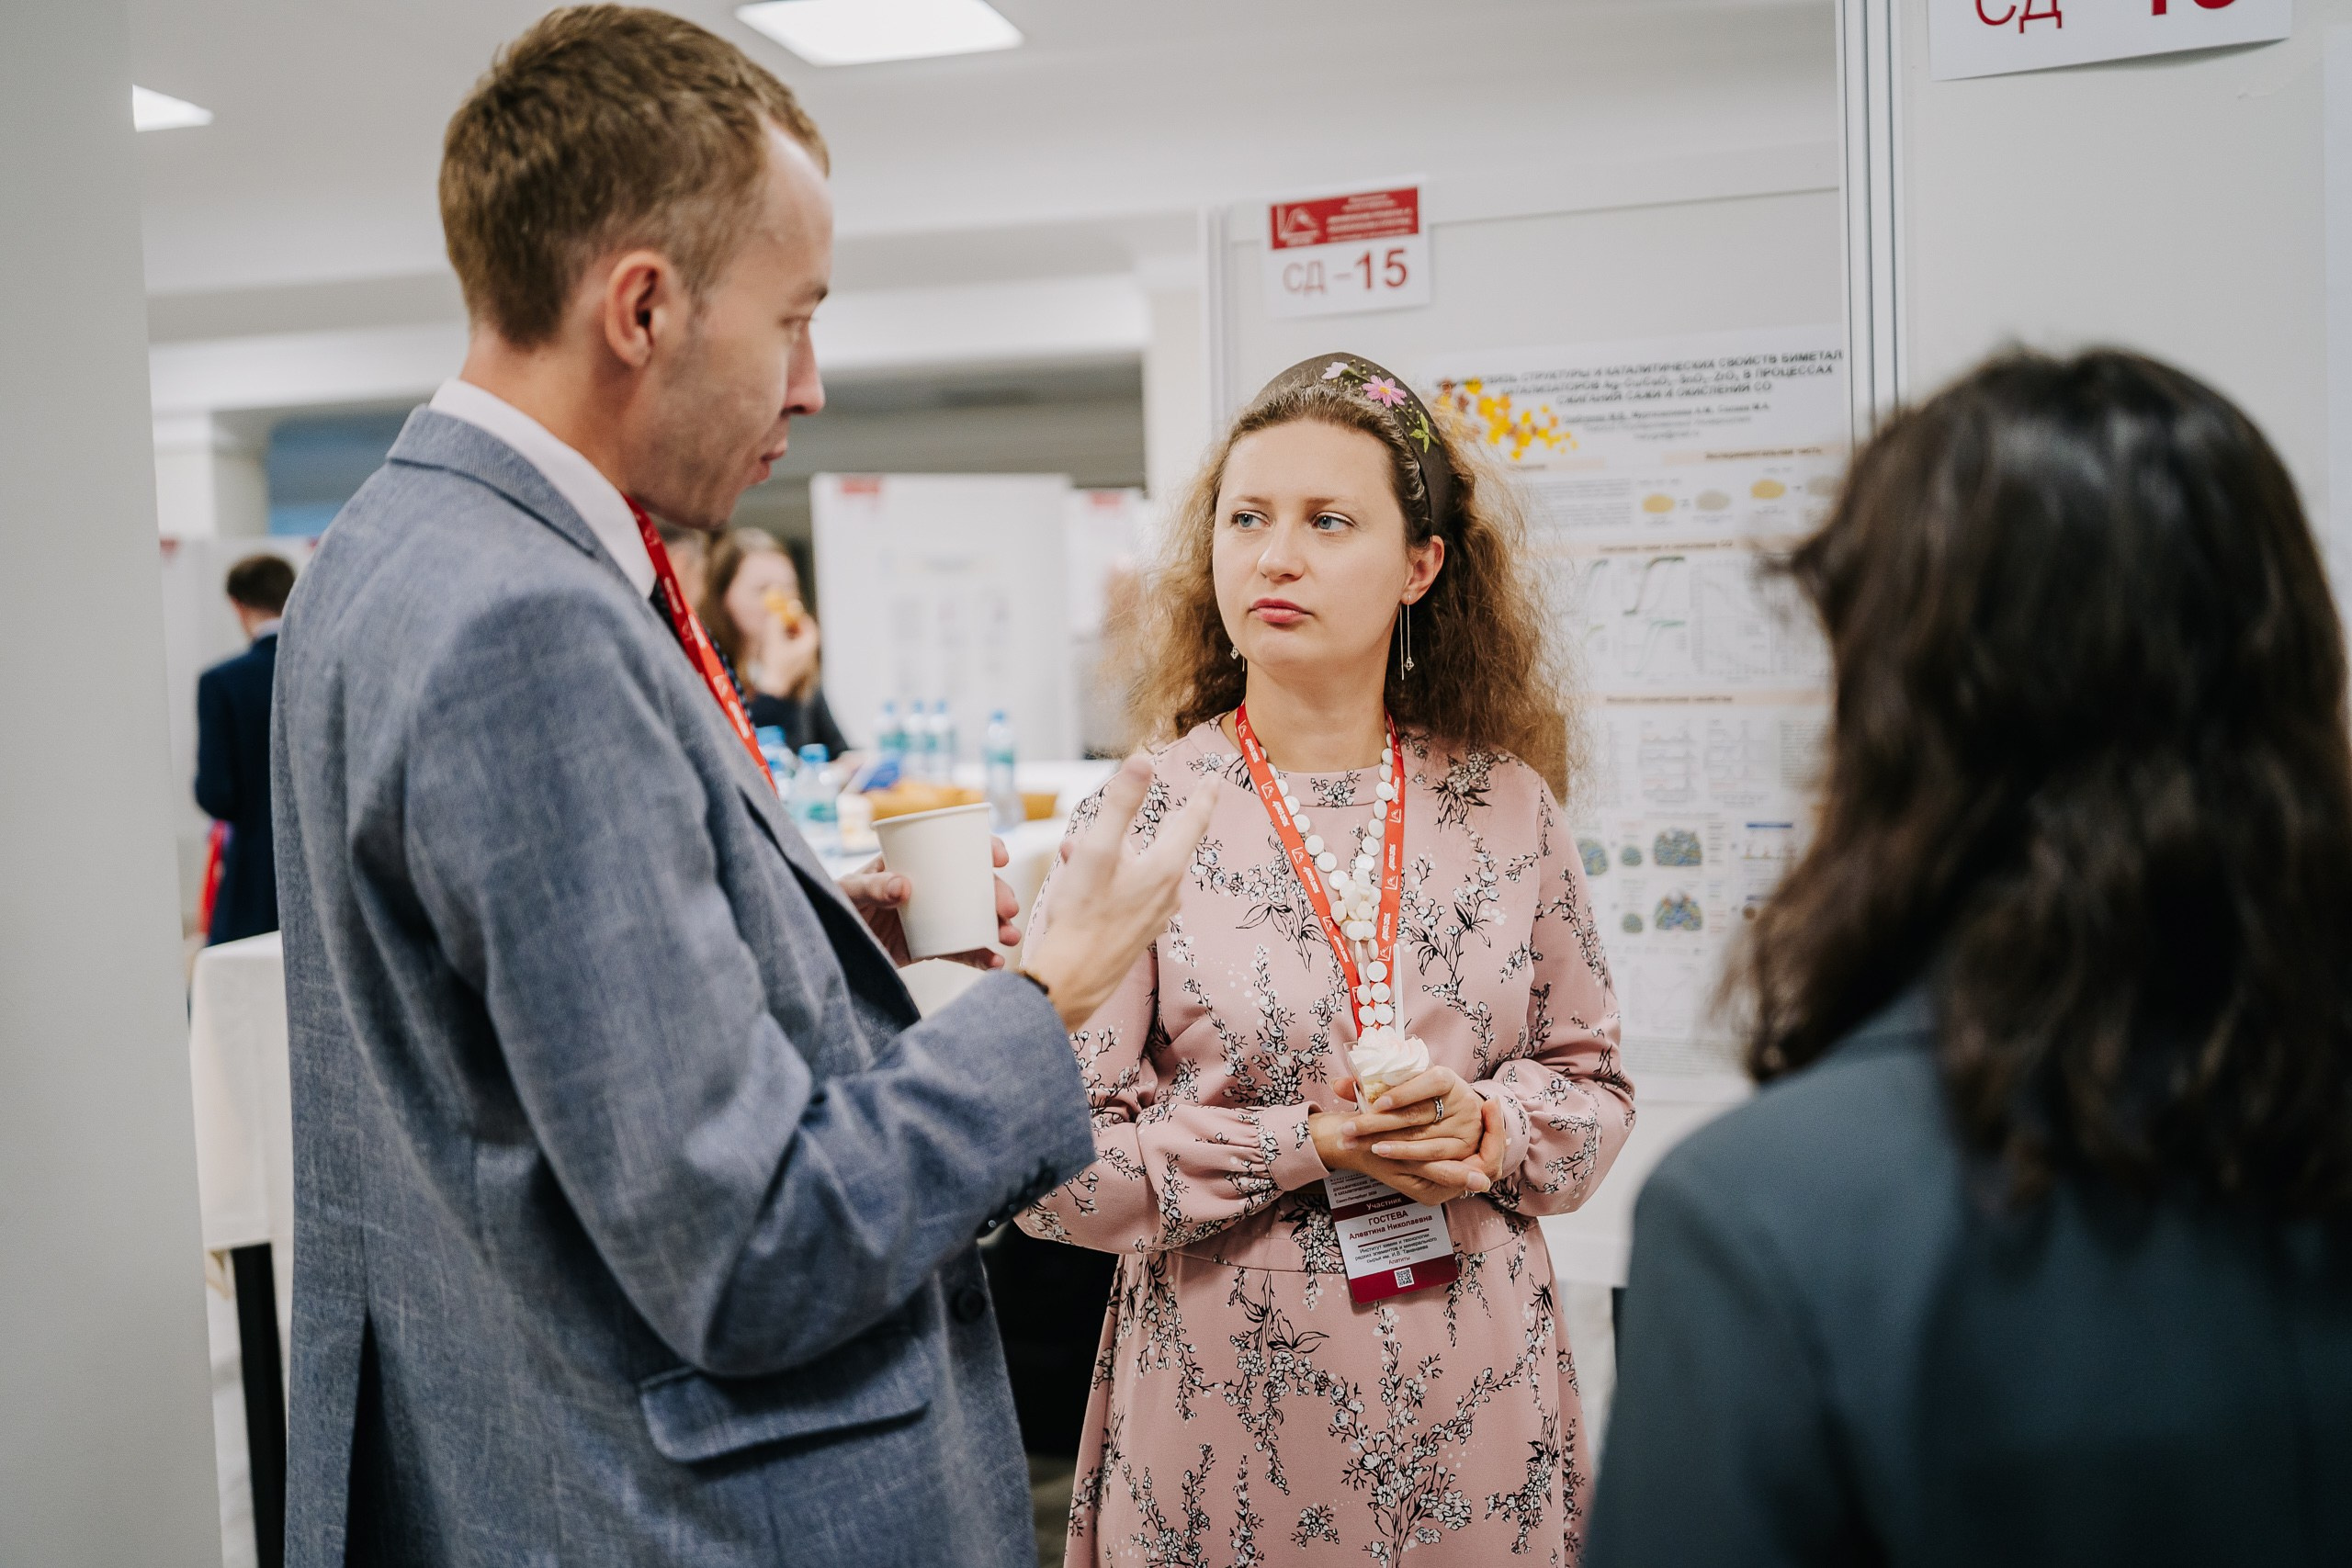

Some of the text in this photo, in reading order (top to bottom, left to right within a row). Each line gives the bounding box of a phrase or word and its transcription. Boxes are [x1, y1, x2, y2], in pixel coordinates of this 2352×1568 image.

[1283, 260, 1326, 295] СД
[1719, 355, 1777, 368] СВОЙСТВ
[1755, 364, 1833, 378] ПРОЦЕССАХ
[1366, 1197, 1402, 1210] Участник
[1368, 1210, 1408, 1226] ГОСТЕВА
[1349, 1214, 1433, 1240] Алевтина Николаевна
[1360, 1244, 1382, 1254] Институт
[1388, 1256, 1411, 1265] Апатиты
